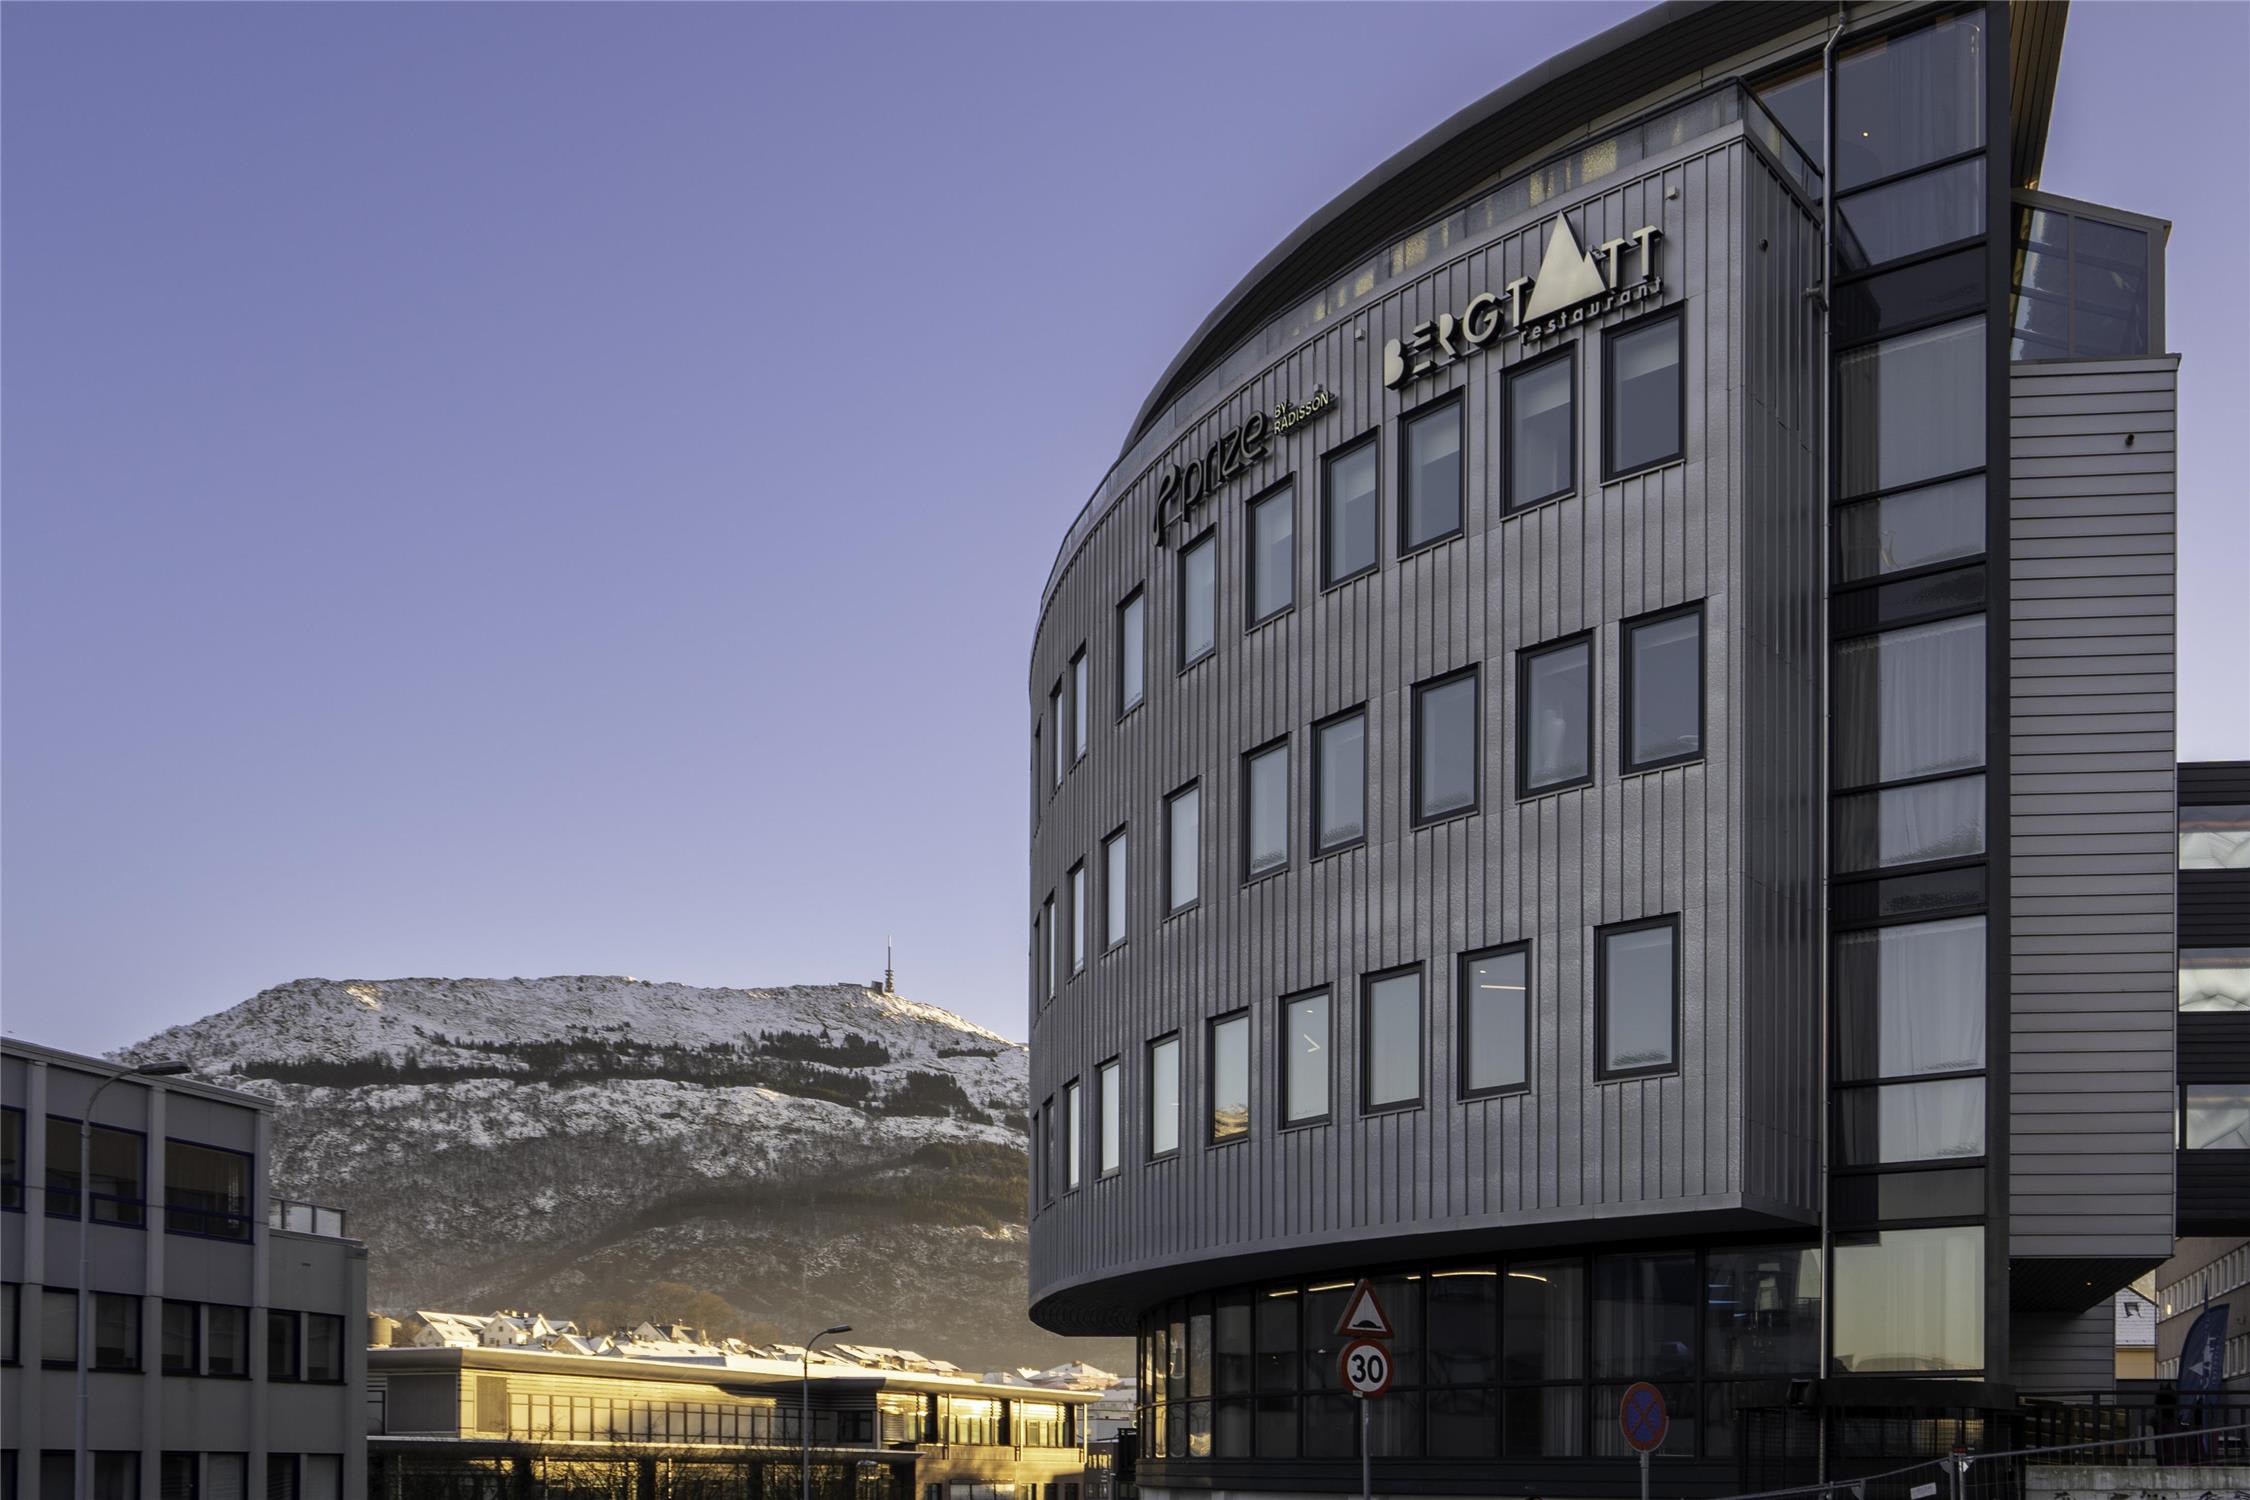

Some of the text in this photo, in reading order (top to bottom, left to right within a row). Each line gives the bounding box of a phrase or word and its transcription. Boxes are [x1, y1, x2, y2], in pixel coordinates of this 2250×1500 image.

[1520, 276, 1662, 344] restaurant
[1273, 390, 1330, 435] RADISSON
[1274, 401, 1289, 418] BY
[1351, 1354, 1384, 1383] 30
